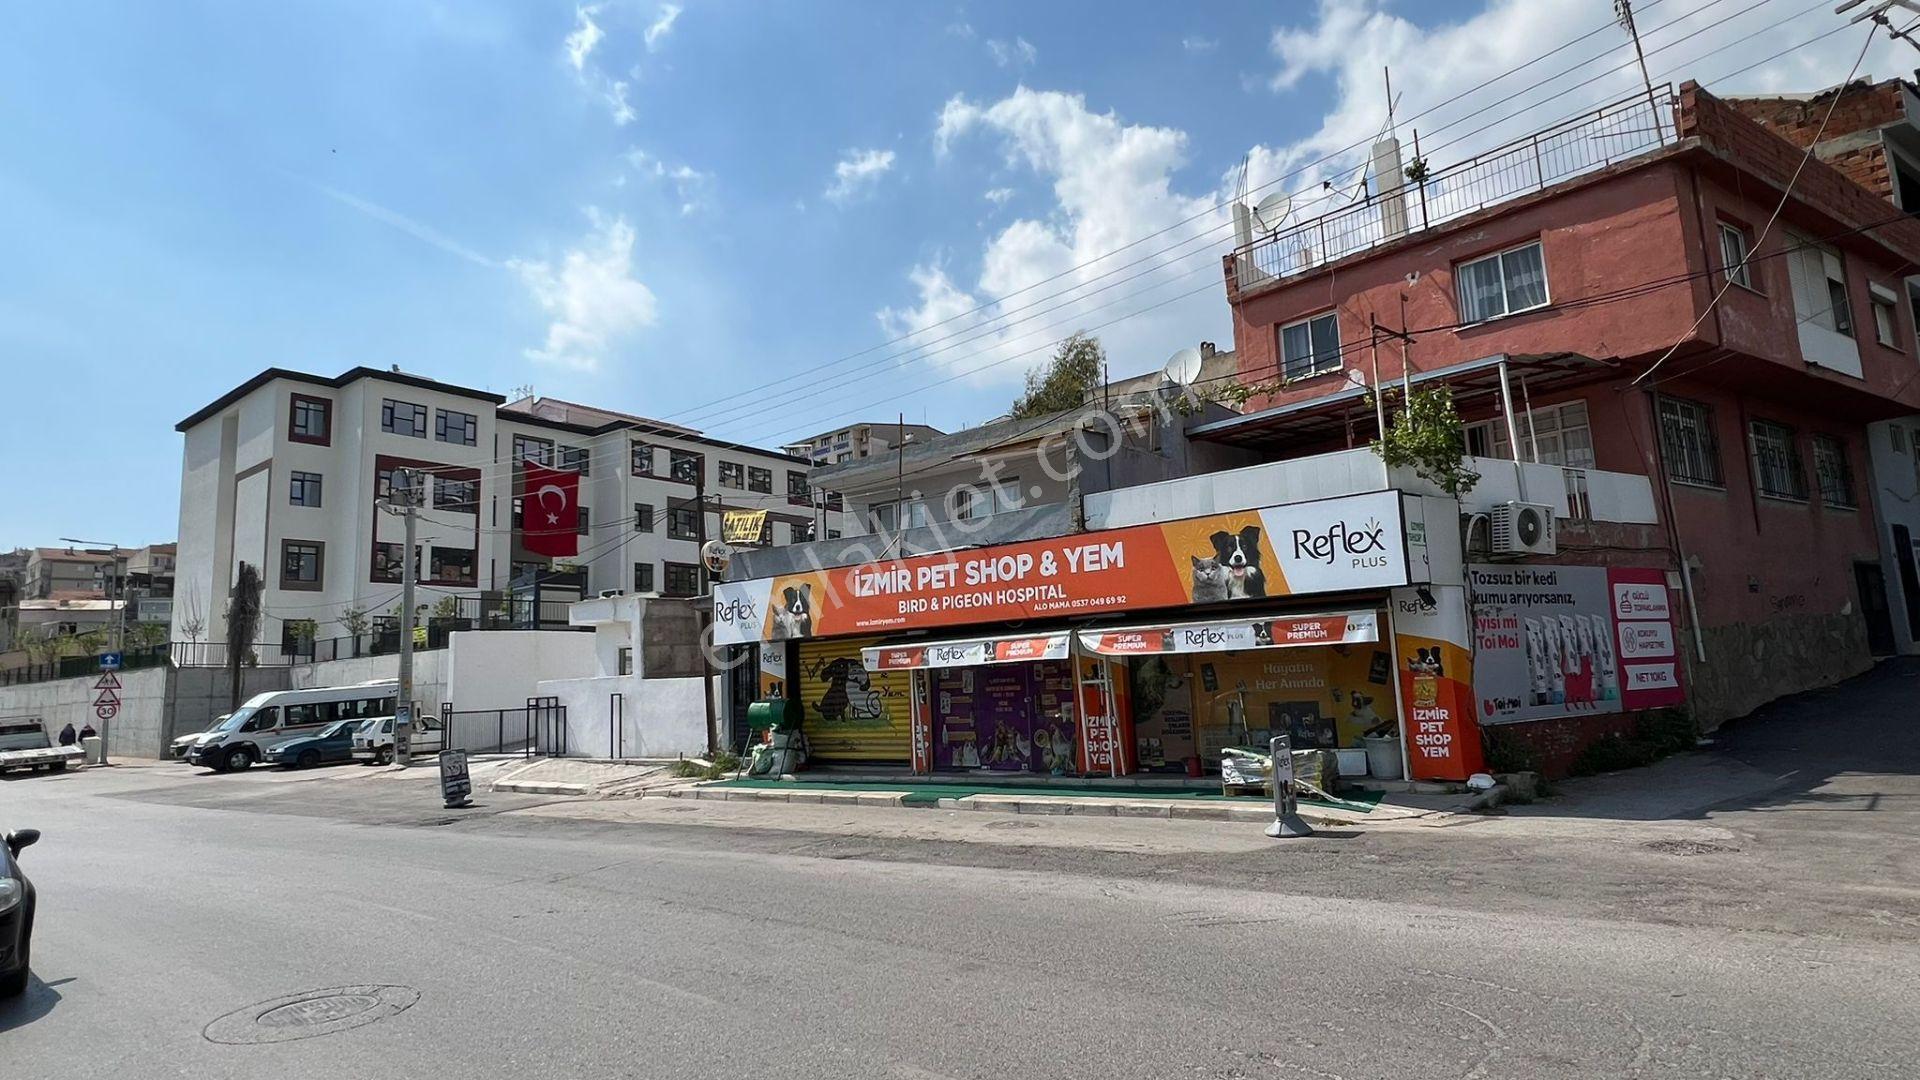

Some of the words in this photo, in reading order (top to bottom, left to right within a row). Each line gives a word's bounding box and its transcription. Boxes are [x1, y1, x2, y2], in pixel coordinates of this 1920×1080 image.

[1292, 520, 1387, 565] Reflex
[1352, 555, 1388, 569] PLUS
[854, 564, 911, 598] İZMİR
[917, 562, 960, 591] PET
[965, 552, 1033, 586] SHOP
[1040, 550, 1058, 577] &
[1062, 541, 1124, 574] YEM
[1471, 570, 1513, 585] Tozsuz
[1515, 570, 1531, 585] bir
[1533, 570, 1557, 586] kedi
[898, 597, 928, 614] BIRD
[930, 597, 939, 610] &
[942, 591, 993, 610] PIGEON
[996, 584, 1067, 605] HOSPITAL
[1033, 601, 1048, 612] ALO
[1048, 599, 1071, 611] MAMA
[1071, 598, 1089, 608] 0537
[1090, 596, 1105, 607] 049
[1105, 595, 1116, 606] 69
[1116, 595, 1126, 605] 92
[1473, 589, 1510, 605] kumu
[1510, 592, 1576, 608] arıyorsanız,
[715, 598, 757, 627] Reflex
[1399, 599, 1437, 613] Reflex
[1292, 622, 1321, 632] SUPER
[1503, 614, 1518, 629] mi
[1117, 634, 1142, 643] SUPER
[1185, 628, 1226, 647] Reflex
[1286, 629, 1328, 640] PREMIUM
[1476, 633, 1496, 649] Toi
[1499, 632, 1520, 649] Moi
[1113, 640, 1147, 650] PREMIUM
[762, 652, 782, 664] Reflex
[936, 647, 966, 663] Reflex
[1263, 662, 1314, 677] Hayatın
[1255, 679, 1276, 691] Her
[100, 707, 114, 716] 30
[1413, 706, 1449, 720] İZMİR
[1420, 721, 1445, 733] PET
[1415, 734, 1452, 746] SHOP
[1420, 746, 1450, 758] YEM
